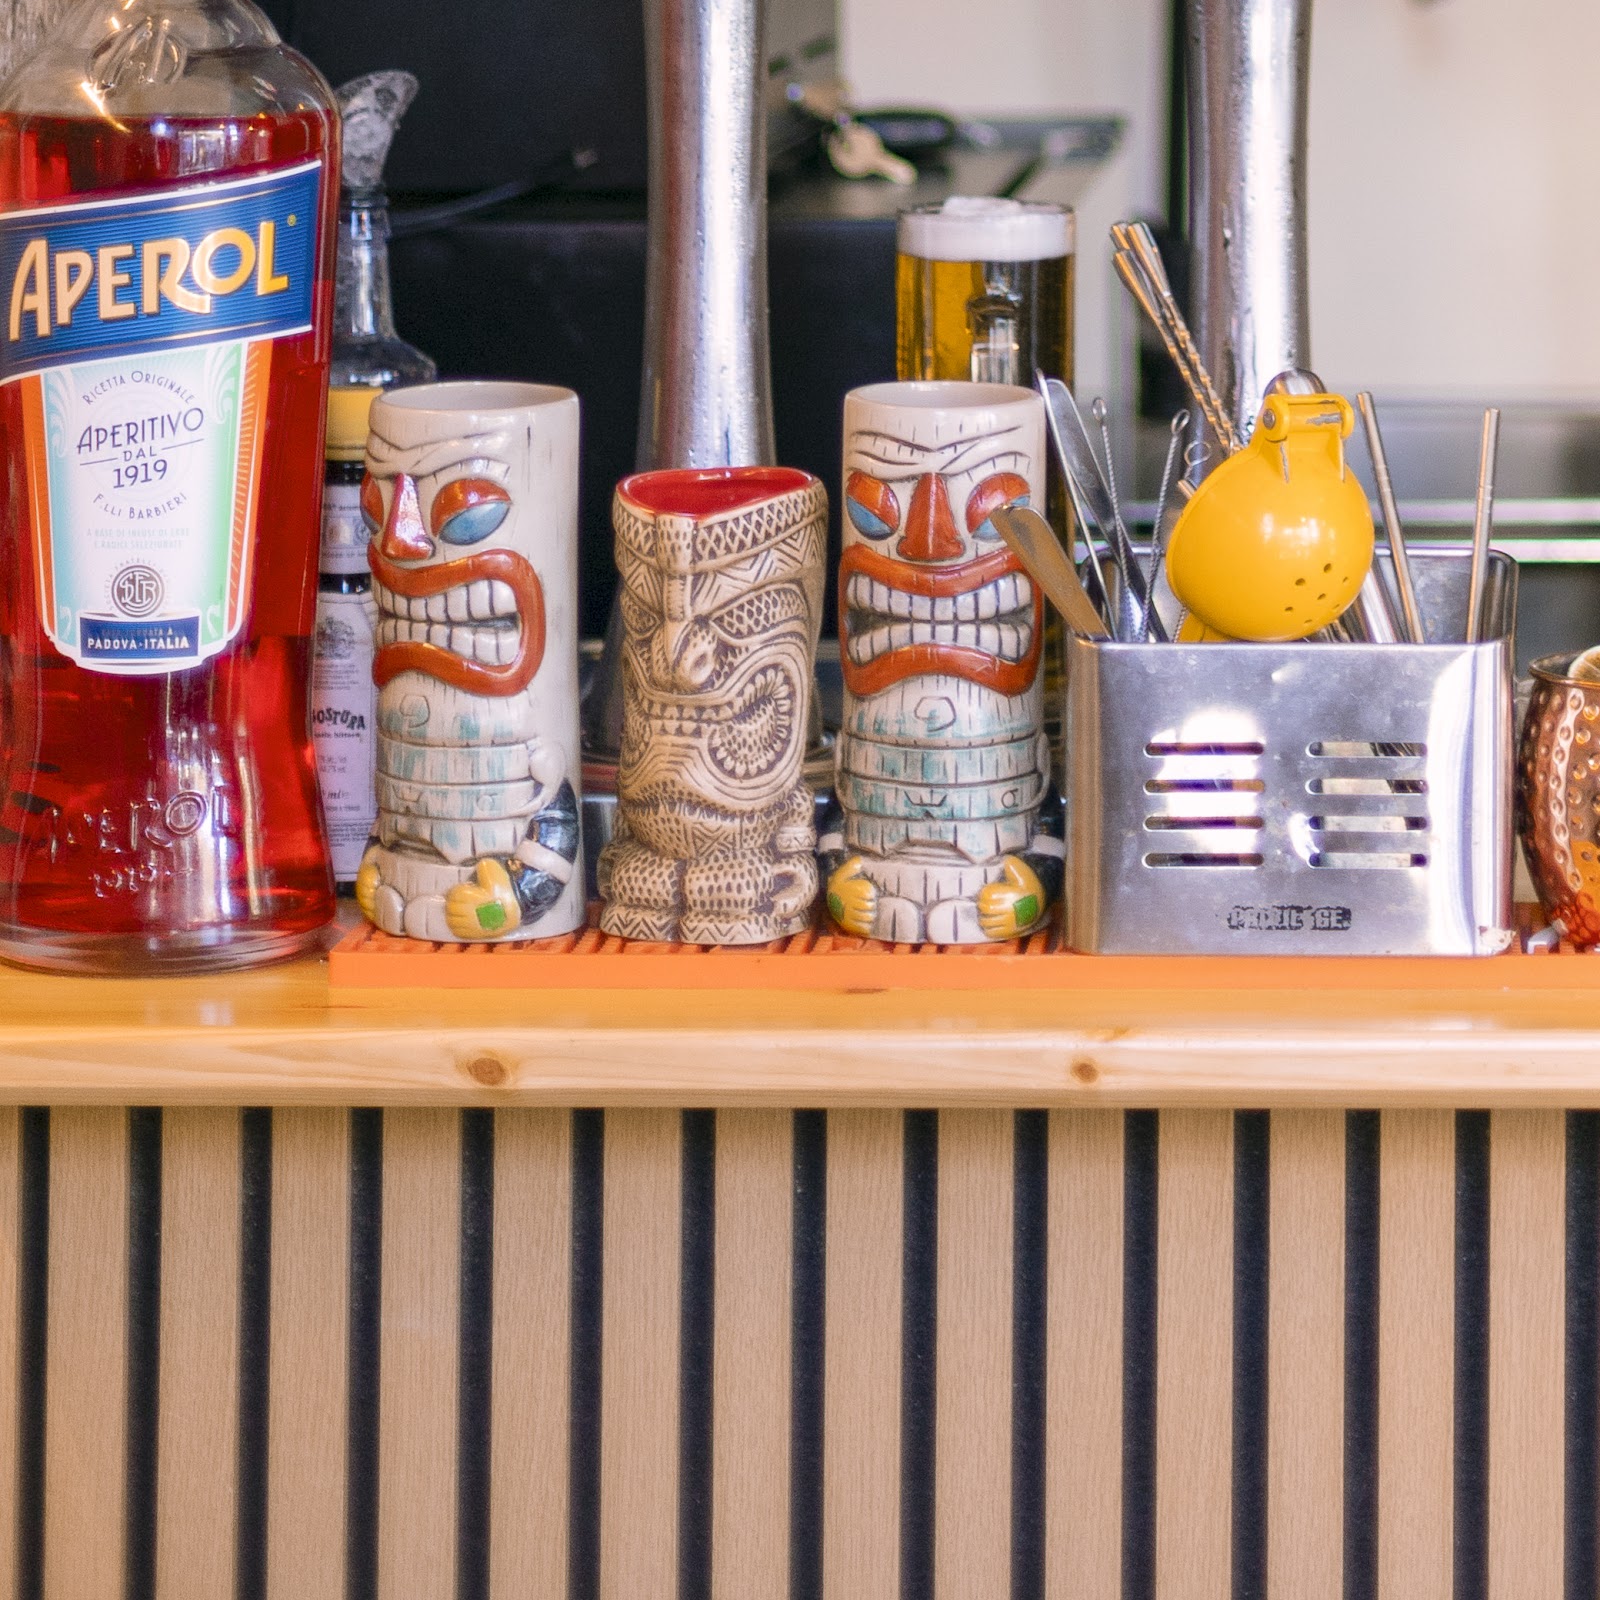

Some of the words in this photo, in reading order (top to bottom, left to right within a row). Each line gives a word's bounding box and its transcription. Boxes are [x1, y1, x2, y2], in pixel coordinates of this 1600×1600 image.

[9, 221, 289, 343] APEROL
[83, 375, 126, 405] RICETTA
[131, 371, 194, 404] ORIGINALE
[76, 407, 204, 455] APERITIVO
[124, 446, 157, 462] DAL
[113, 459, 168, 489] 1919
[129, 492, 187, 519] BARBIERI
[88, 638, 137, 650] PADOVA
[144, 636, 190, 649] ITALIA
